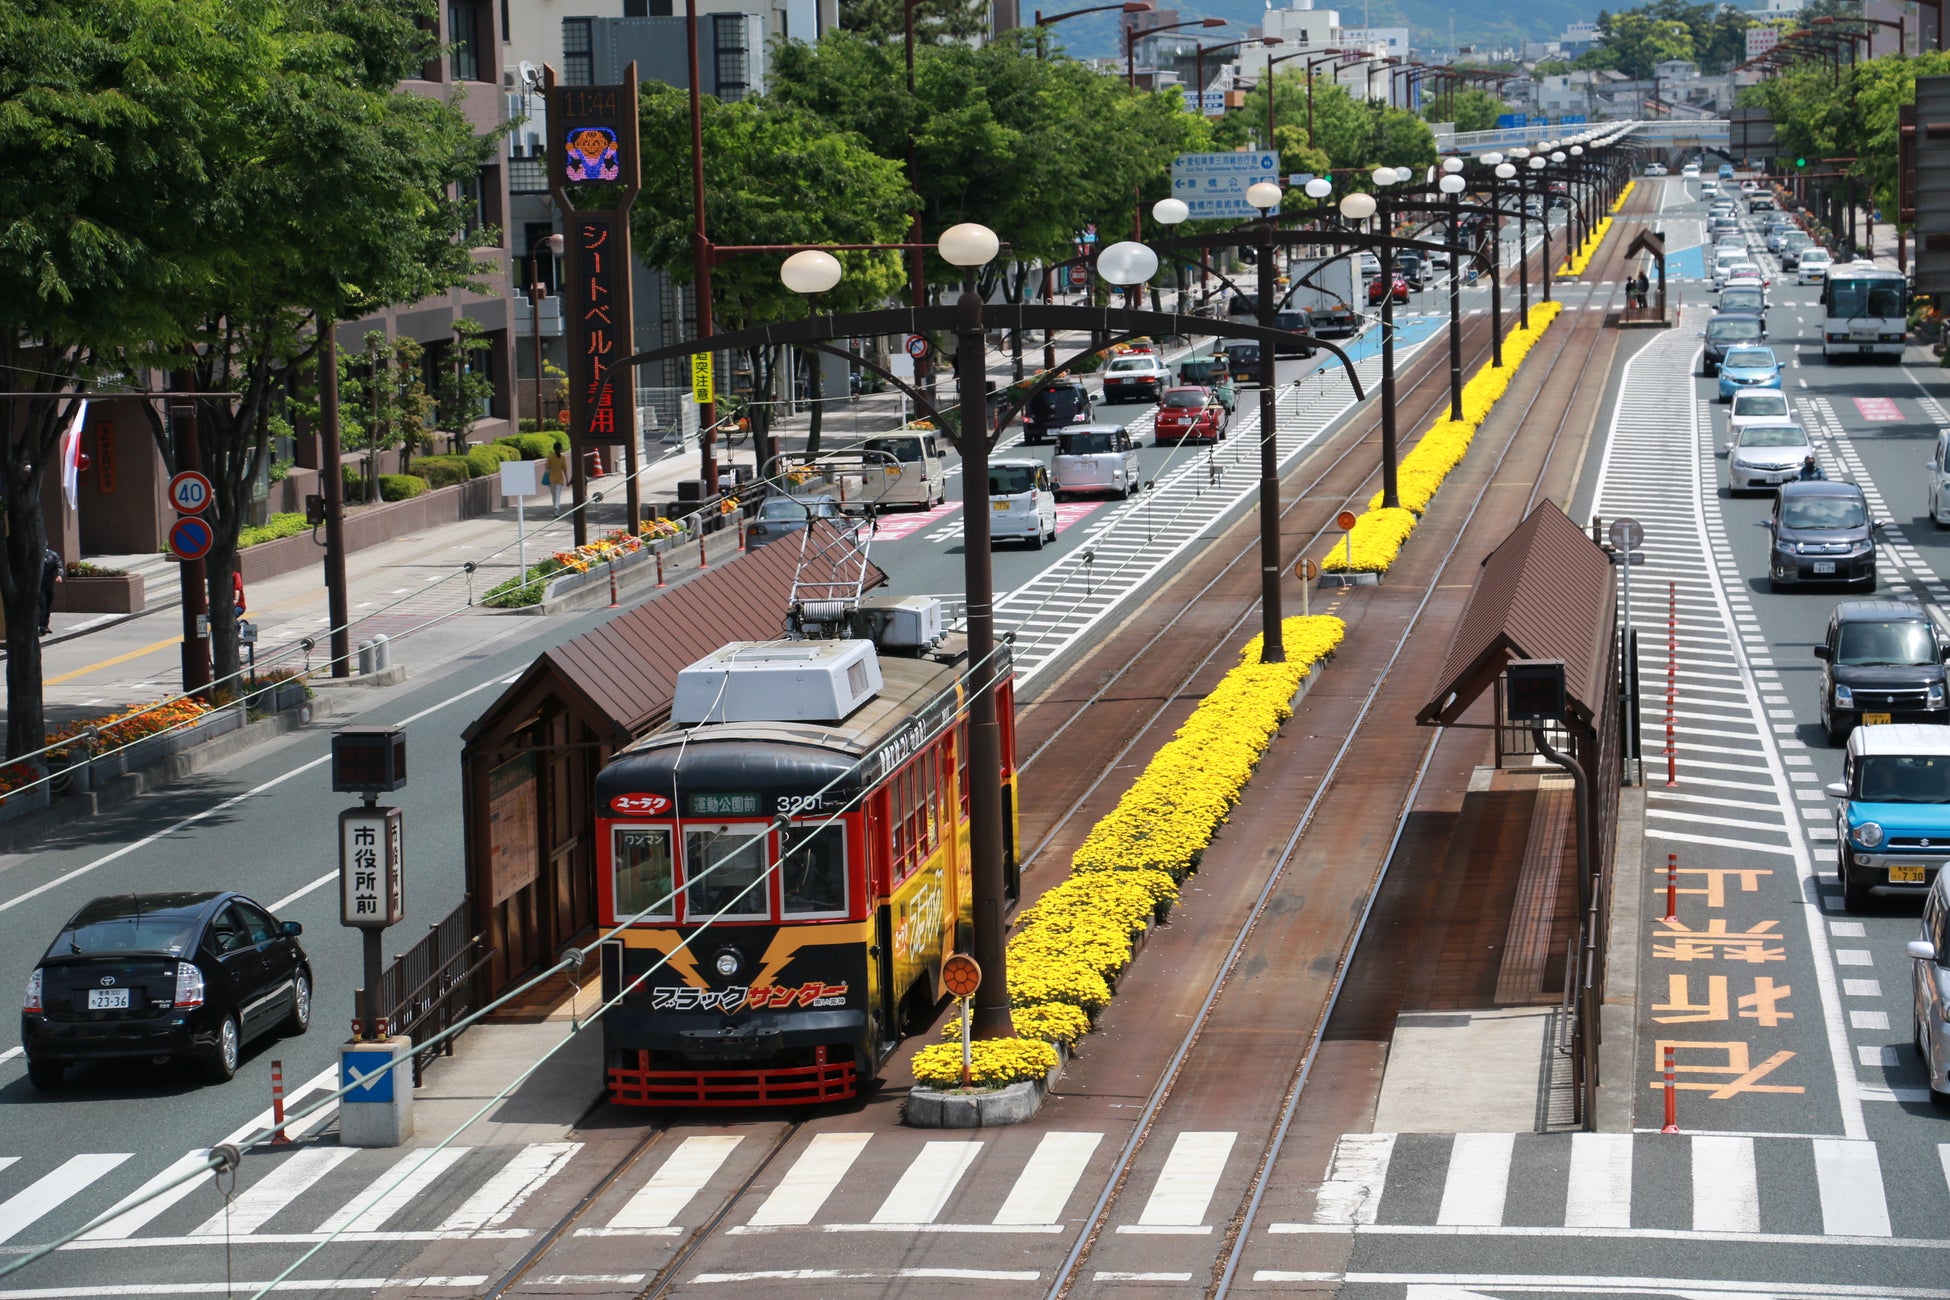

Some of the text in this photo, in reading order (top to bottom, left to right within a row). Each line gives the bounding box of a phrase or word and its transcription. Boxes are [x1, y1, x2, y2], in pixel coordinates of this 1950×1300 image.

[565, 91, 616, 117] 11:44
[179, 483, 202, 503] 40
[616, 797, 667, 809] ユーラク
[693, 796, 756, 813] 運動公園前
[776, 795, 823, 812] 3201
[624, 834, 664, 846] ワンマン
[353, 825, 378, 914] 市役所前
[97, 996, 127, 1007] 23-36
